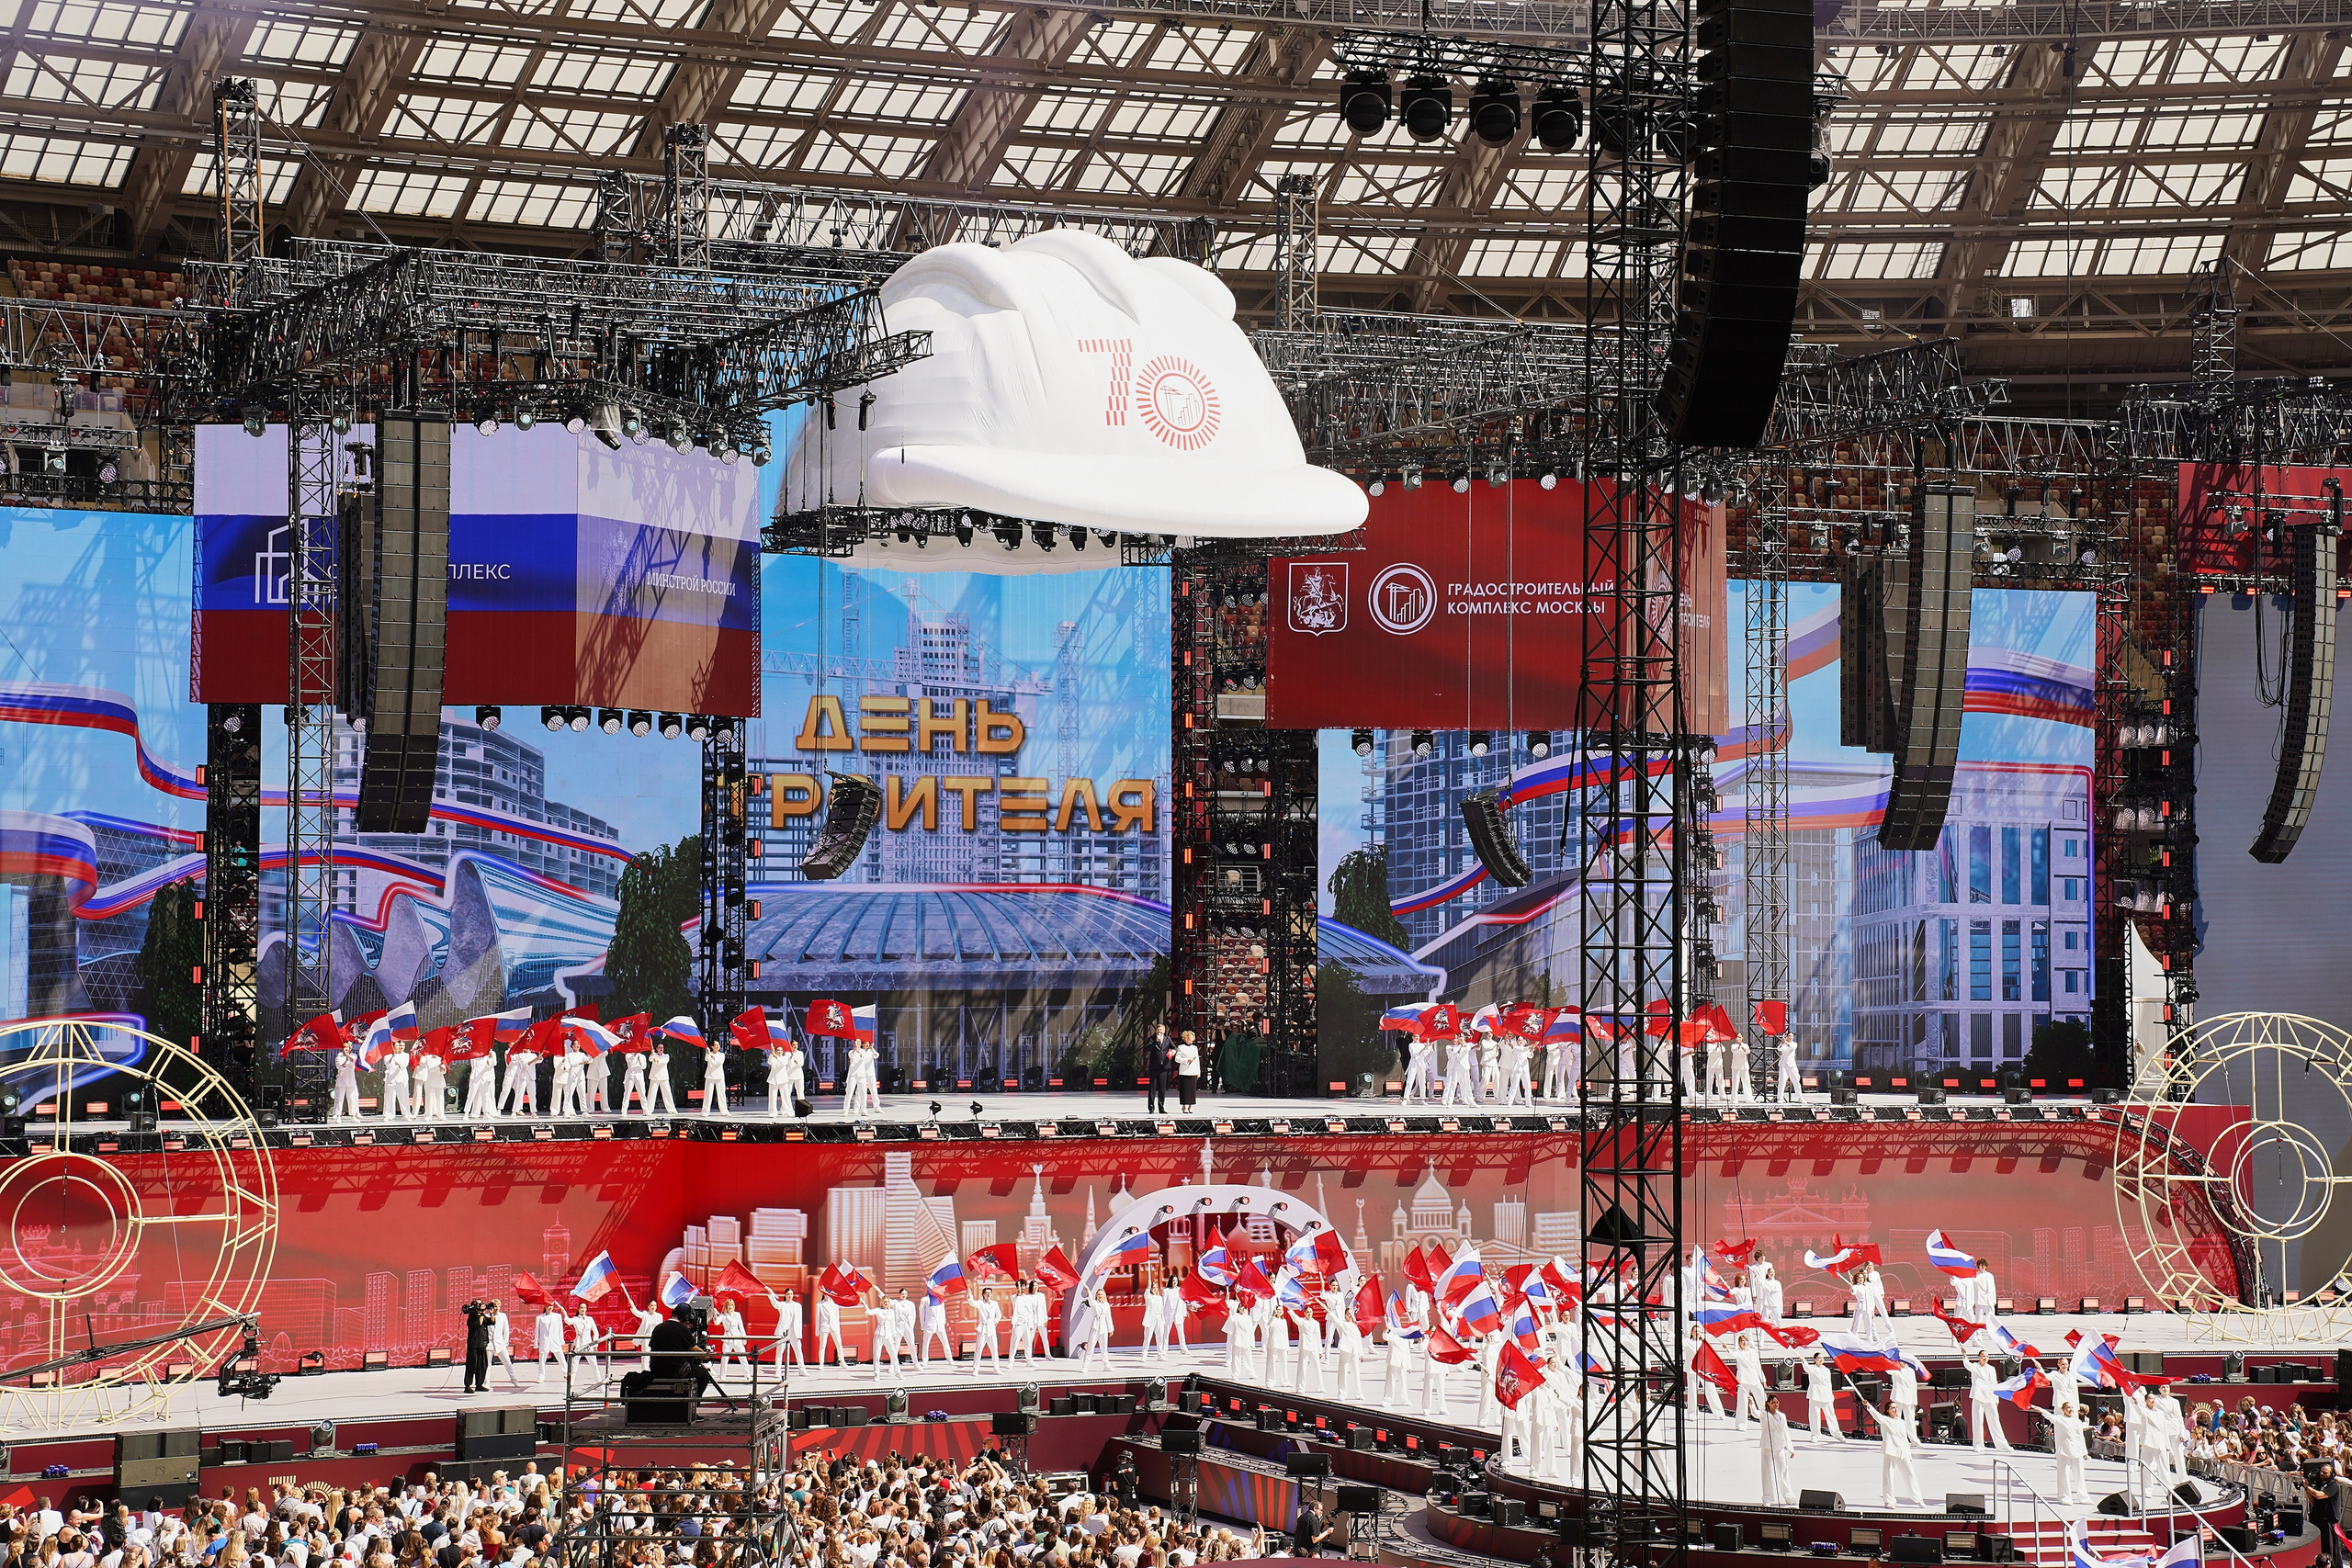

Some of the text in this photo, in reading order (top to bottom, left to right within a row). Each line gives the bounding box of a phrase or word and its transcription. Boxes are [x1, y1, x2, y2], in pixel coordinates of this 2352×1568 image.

[447, 563, 511, 581] ПЛЕКС
[646, 571, 736, 596] МИНСТРОЙ РОССИИ
[1447, 579, 1614, 597] ГРАДОСТРОИТЕЛЬЫЙ
[1679, 592, 1692, 607] ЕНЬ
[1679, 612, 1710, 628] ТРОИТЕЛЯ
[796, 694, 1025, 754] ДЕНЬ
